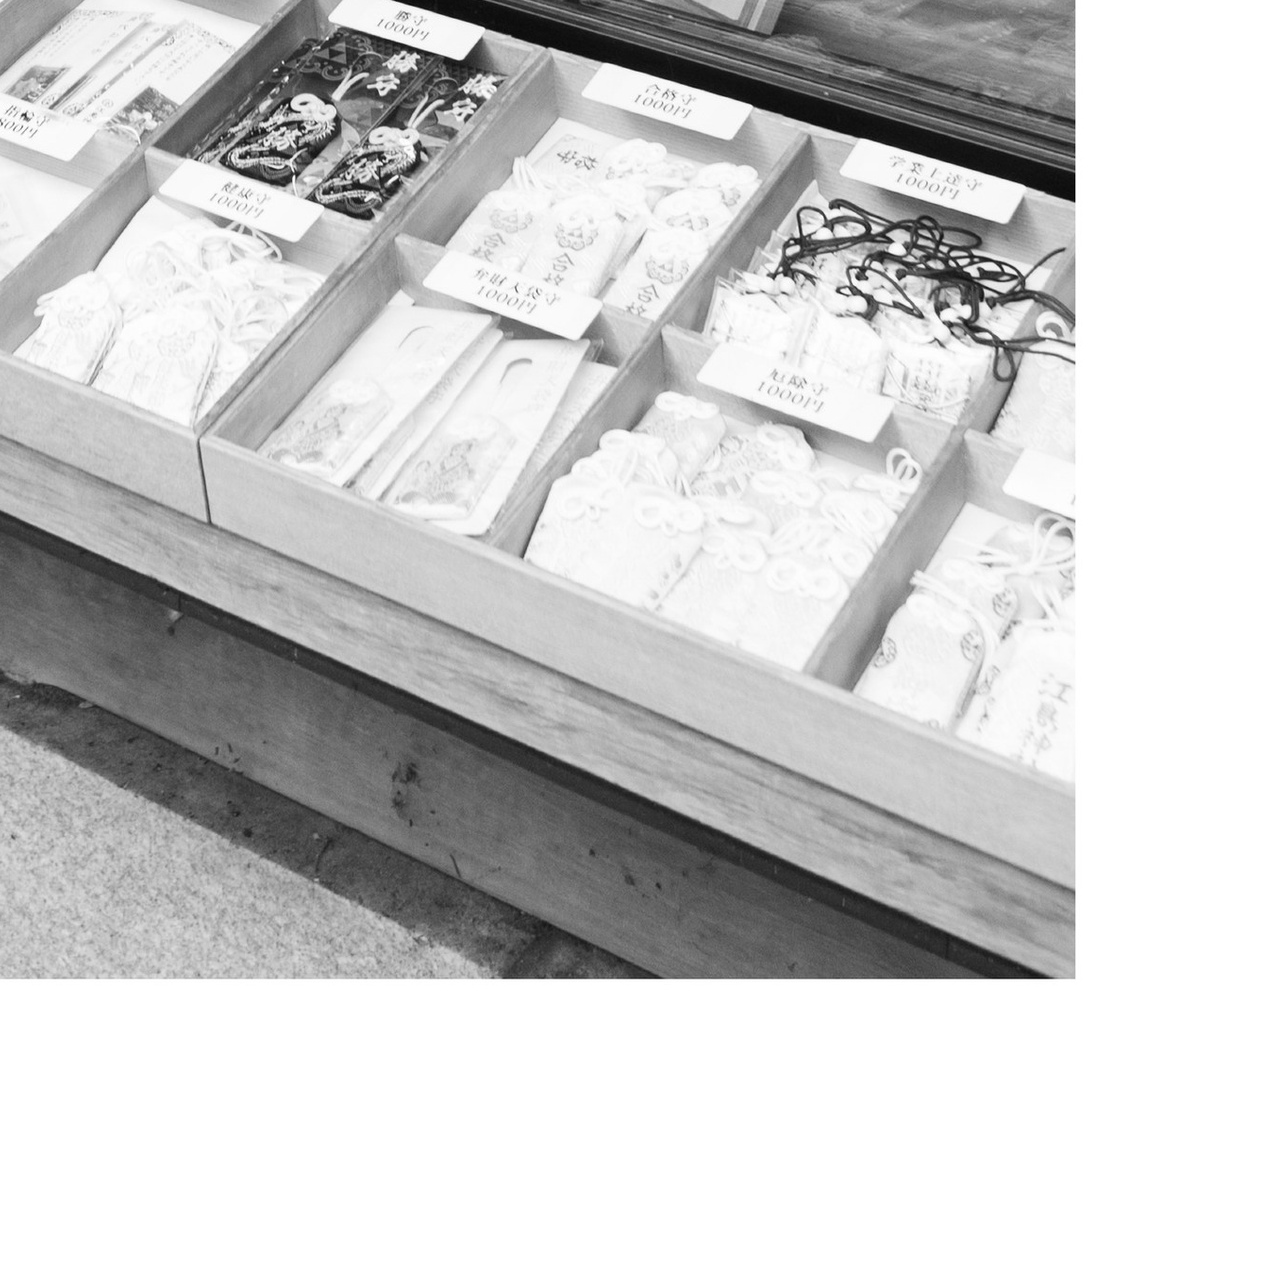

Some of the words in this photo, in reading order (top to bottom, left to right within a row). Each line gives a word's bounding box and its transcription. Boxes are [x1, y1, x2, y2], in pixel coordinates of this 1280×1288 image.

[376, 18, 430, 41] 1000円
[634, 93, 692, 120] 1000円
[896, 172, 960, 201] 1000円
[209, 192, 265, 220] 1000円
[477, 285, 537, 315] 1000円
[757, 381, 824, 413] 1000円
